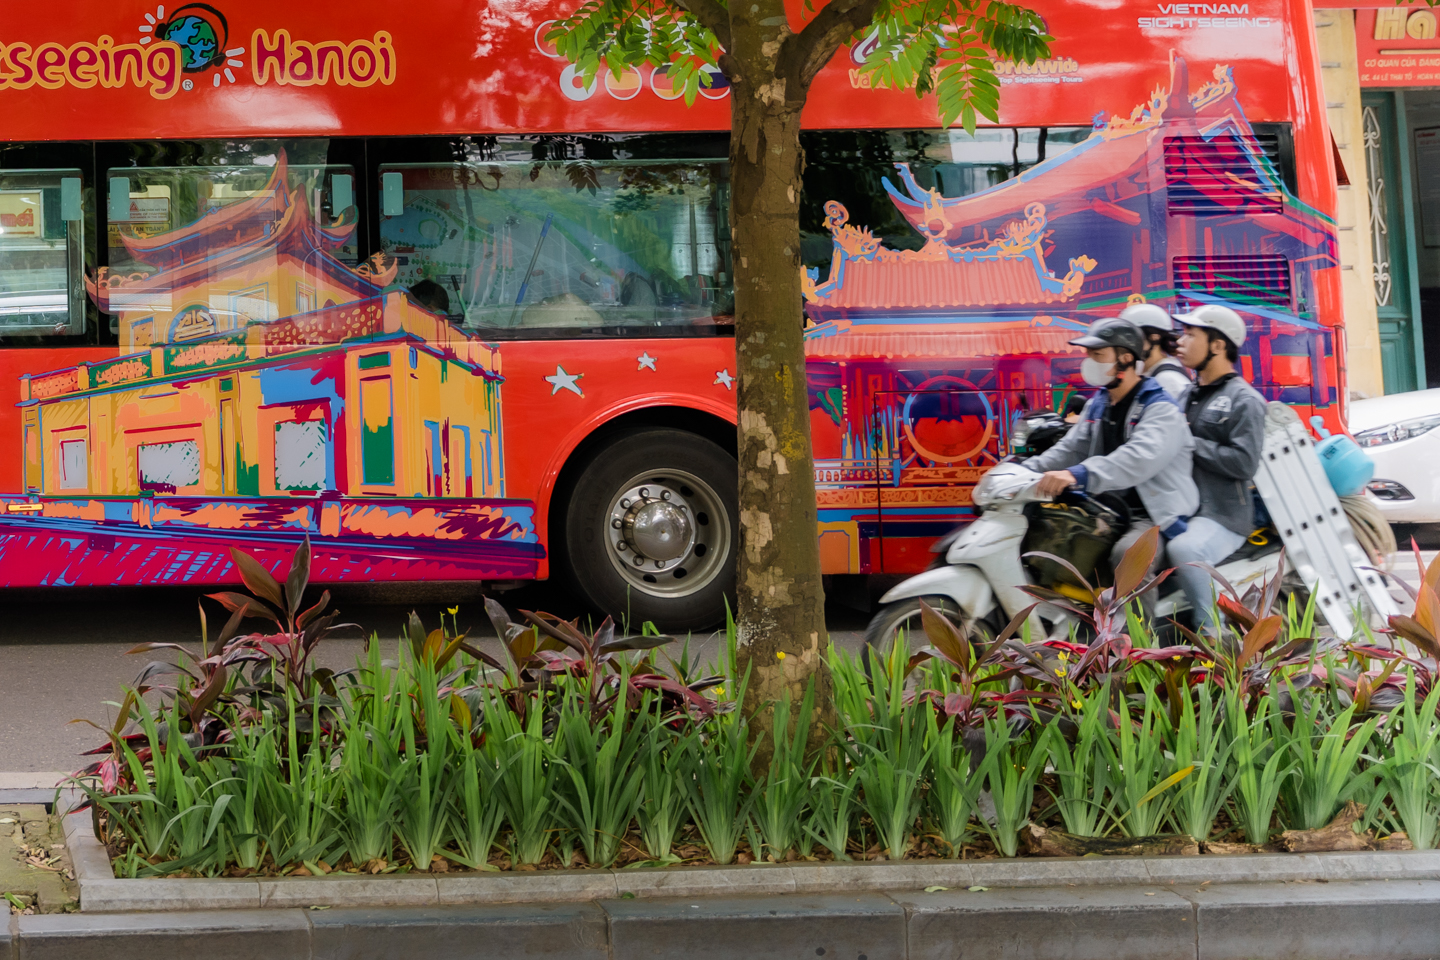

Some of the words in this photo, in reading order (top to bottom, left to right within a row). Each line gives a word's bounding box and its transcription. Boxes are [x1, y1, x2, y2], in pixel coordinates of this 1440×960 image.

[1157, 3, 1249, 14] VIETNAM
[1137, 17, 1270, 28] SIGHTSEEING
[250, 28, 397, 89] Hanoi
[1377, 59, 1400, 67] QUAN
[987, 56, 1078, 75] orldwide
[1015, 76, 1060, 84] Sightseeing
